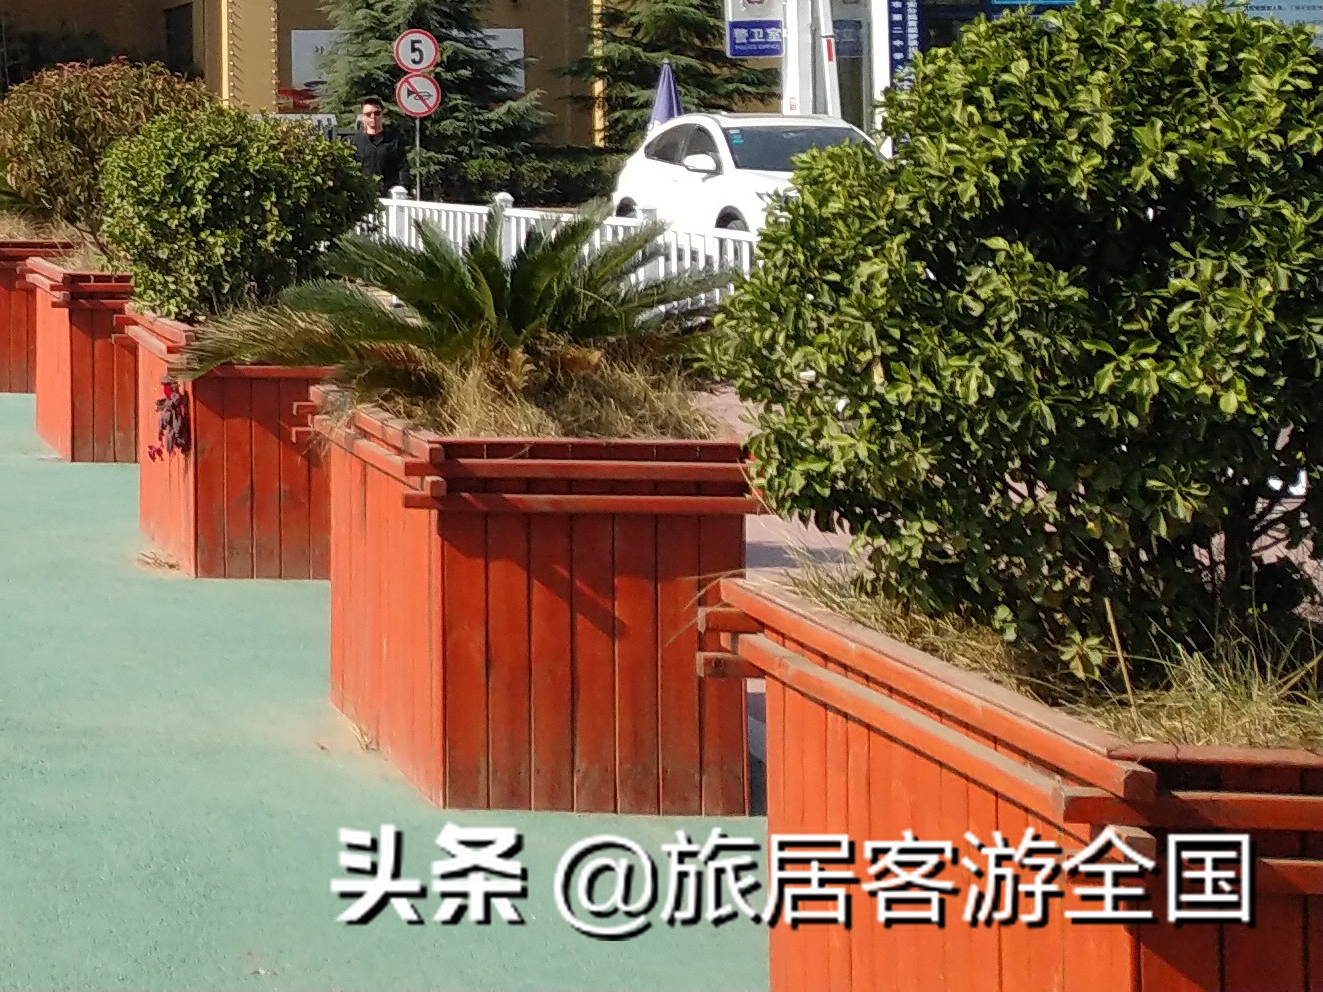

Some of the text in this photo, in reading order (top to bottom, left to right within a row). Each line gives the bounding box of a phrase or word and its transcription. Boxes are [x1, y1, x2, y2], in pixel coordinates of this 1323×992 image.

[733, 27, 783, 43] 警卫室
[410, 39, 424, 65] 5
